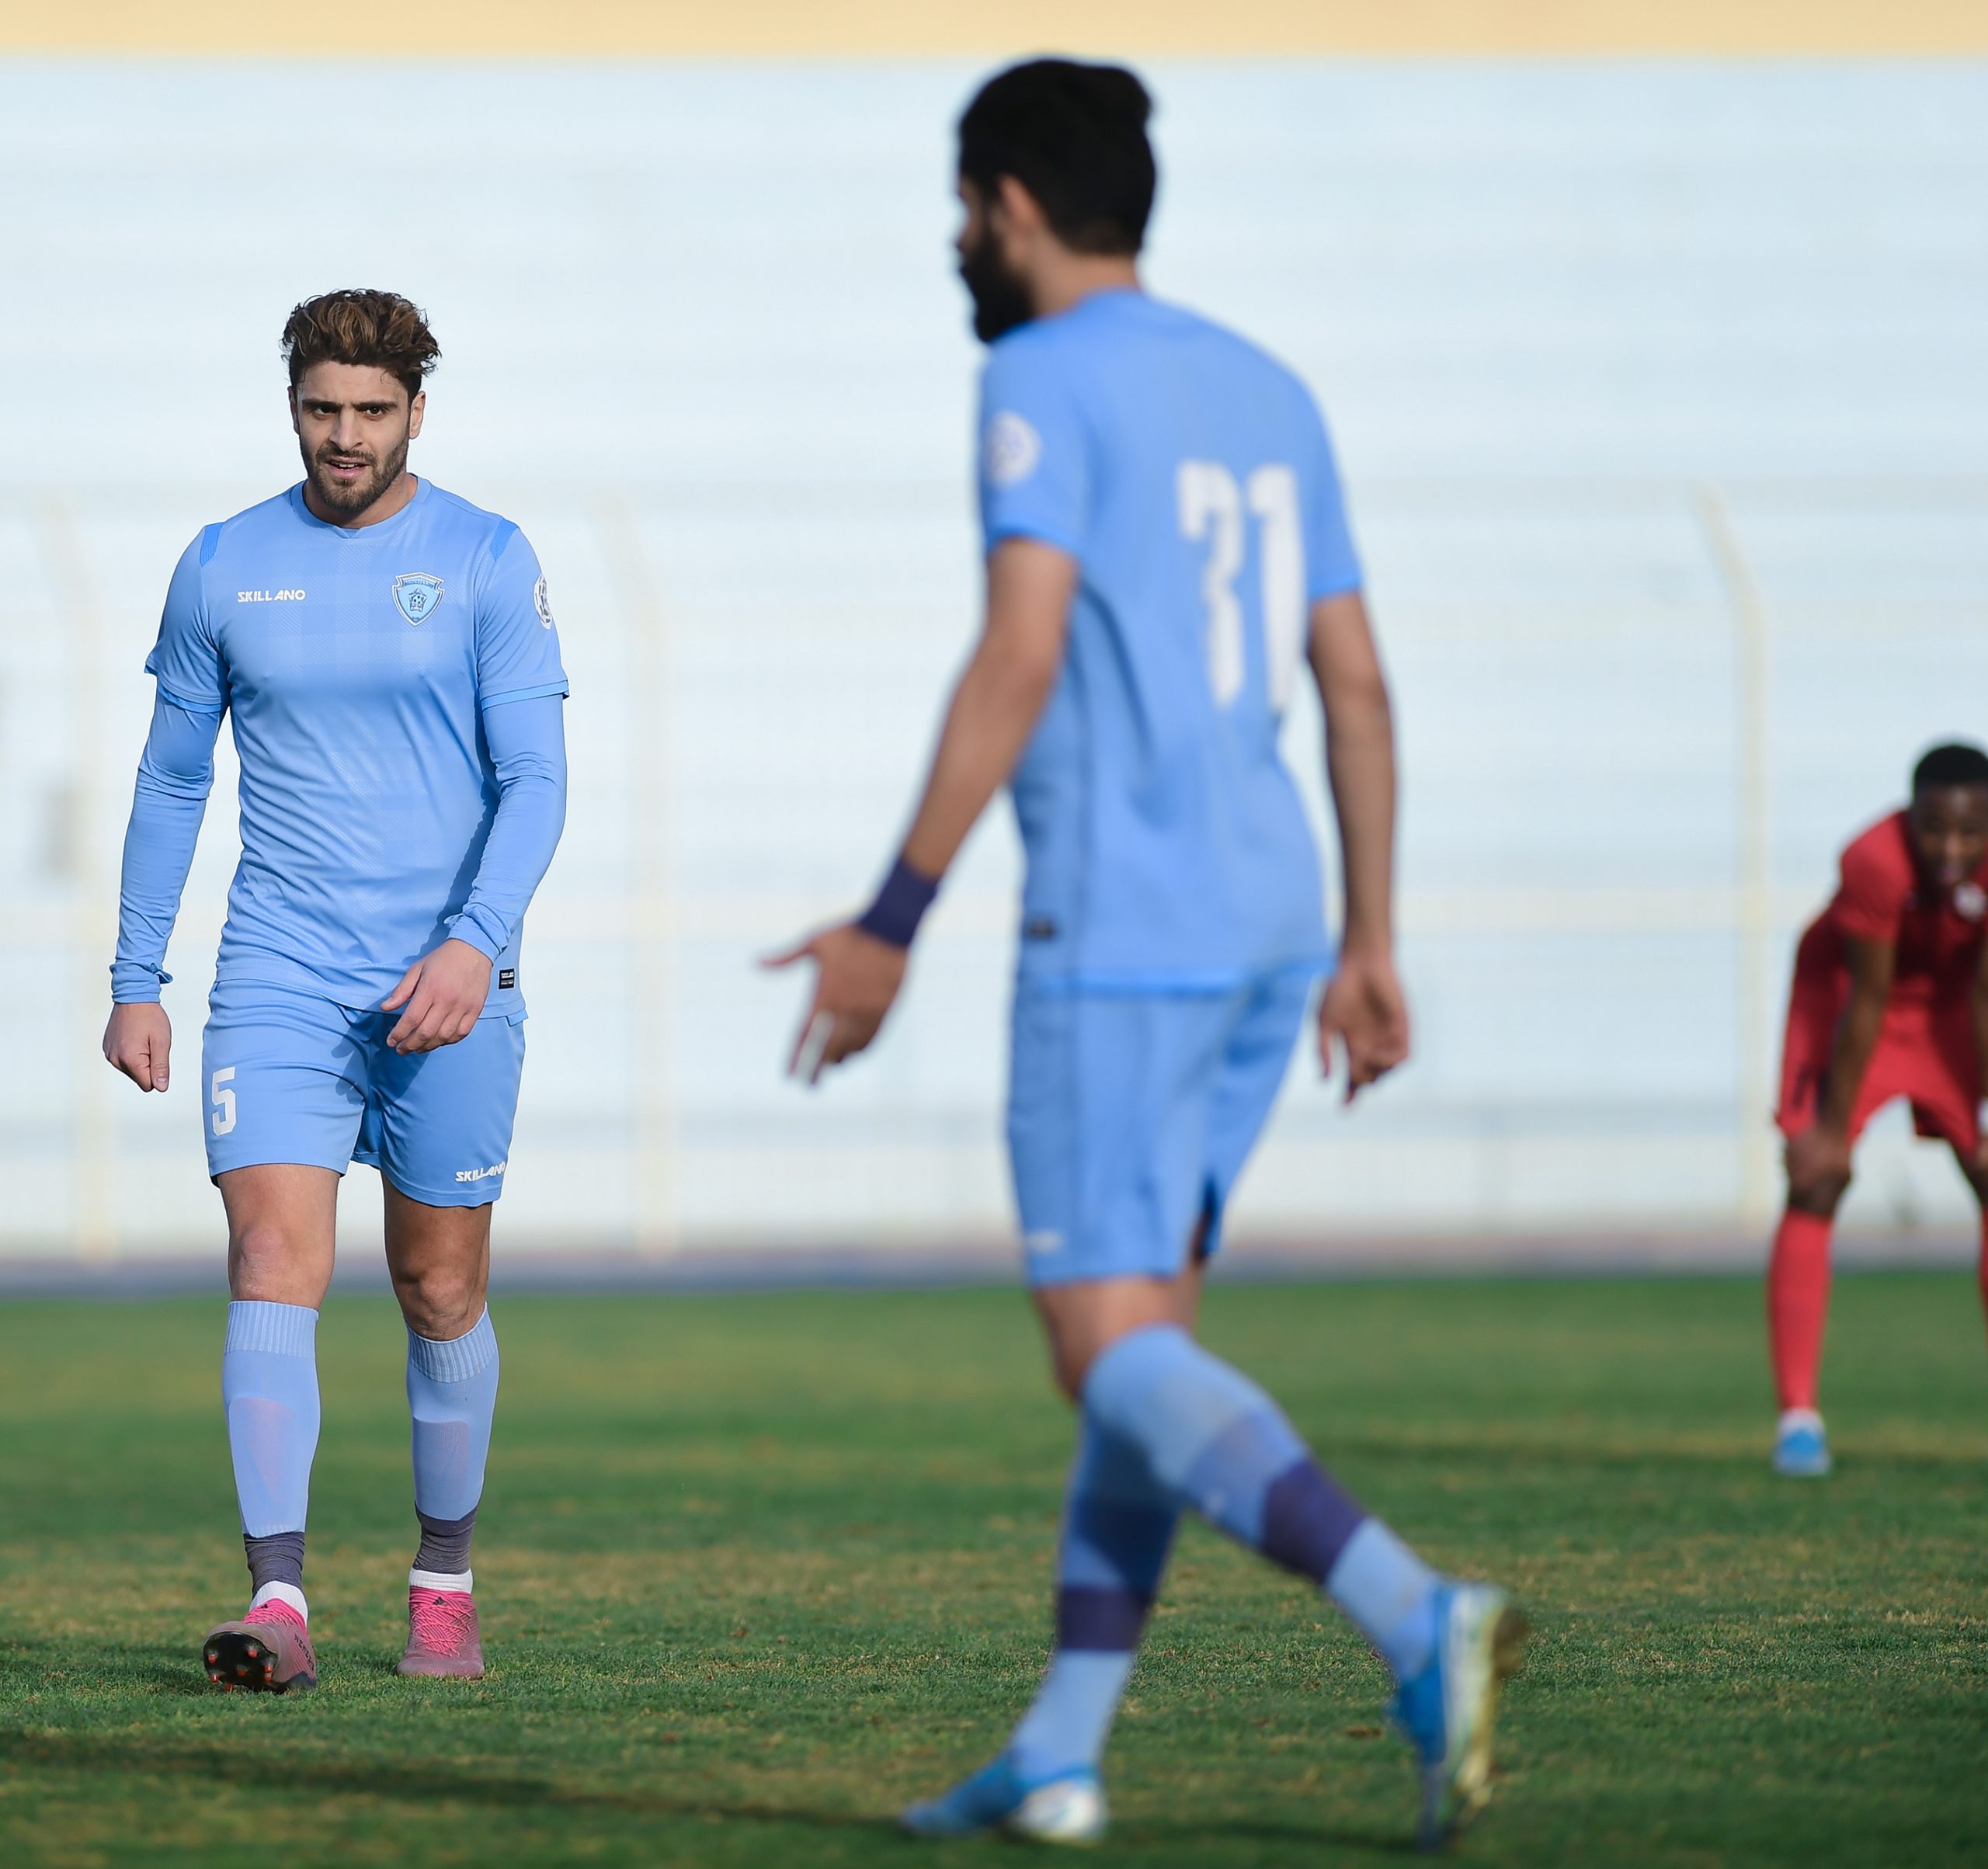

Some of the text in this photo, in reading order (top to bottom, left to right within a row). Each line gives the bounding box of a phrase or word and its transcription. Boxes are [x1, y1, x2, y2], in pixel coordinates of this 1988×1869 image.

[237, 589, 306, 603] SKILLANO
[1176, 459, 1306, 712] 31
[211, 1066, 236, 1137] 5
